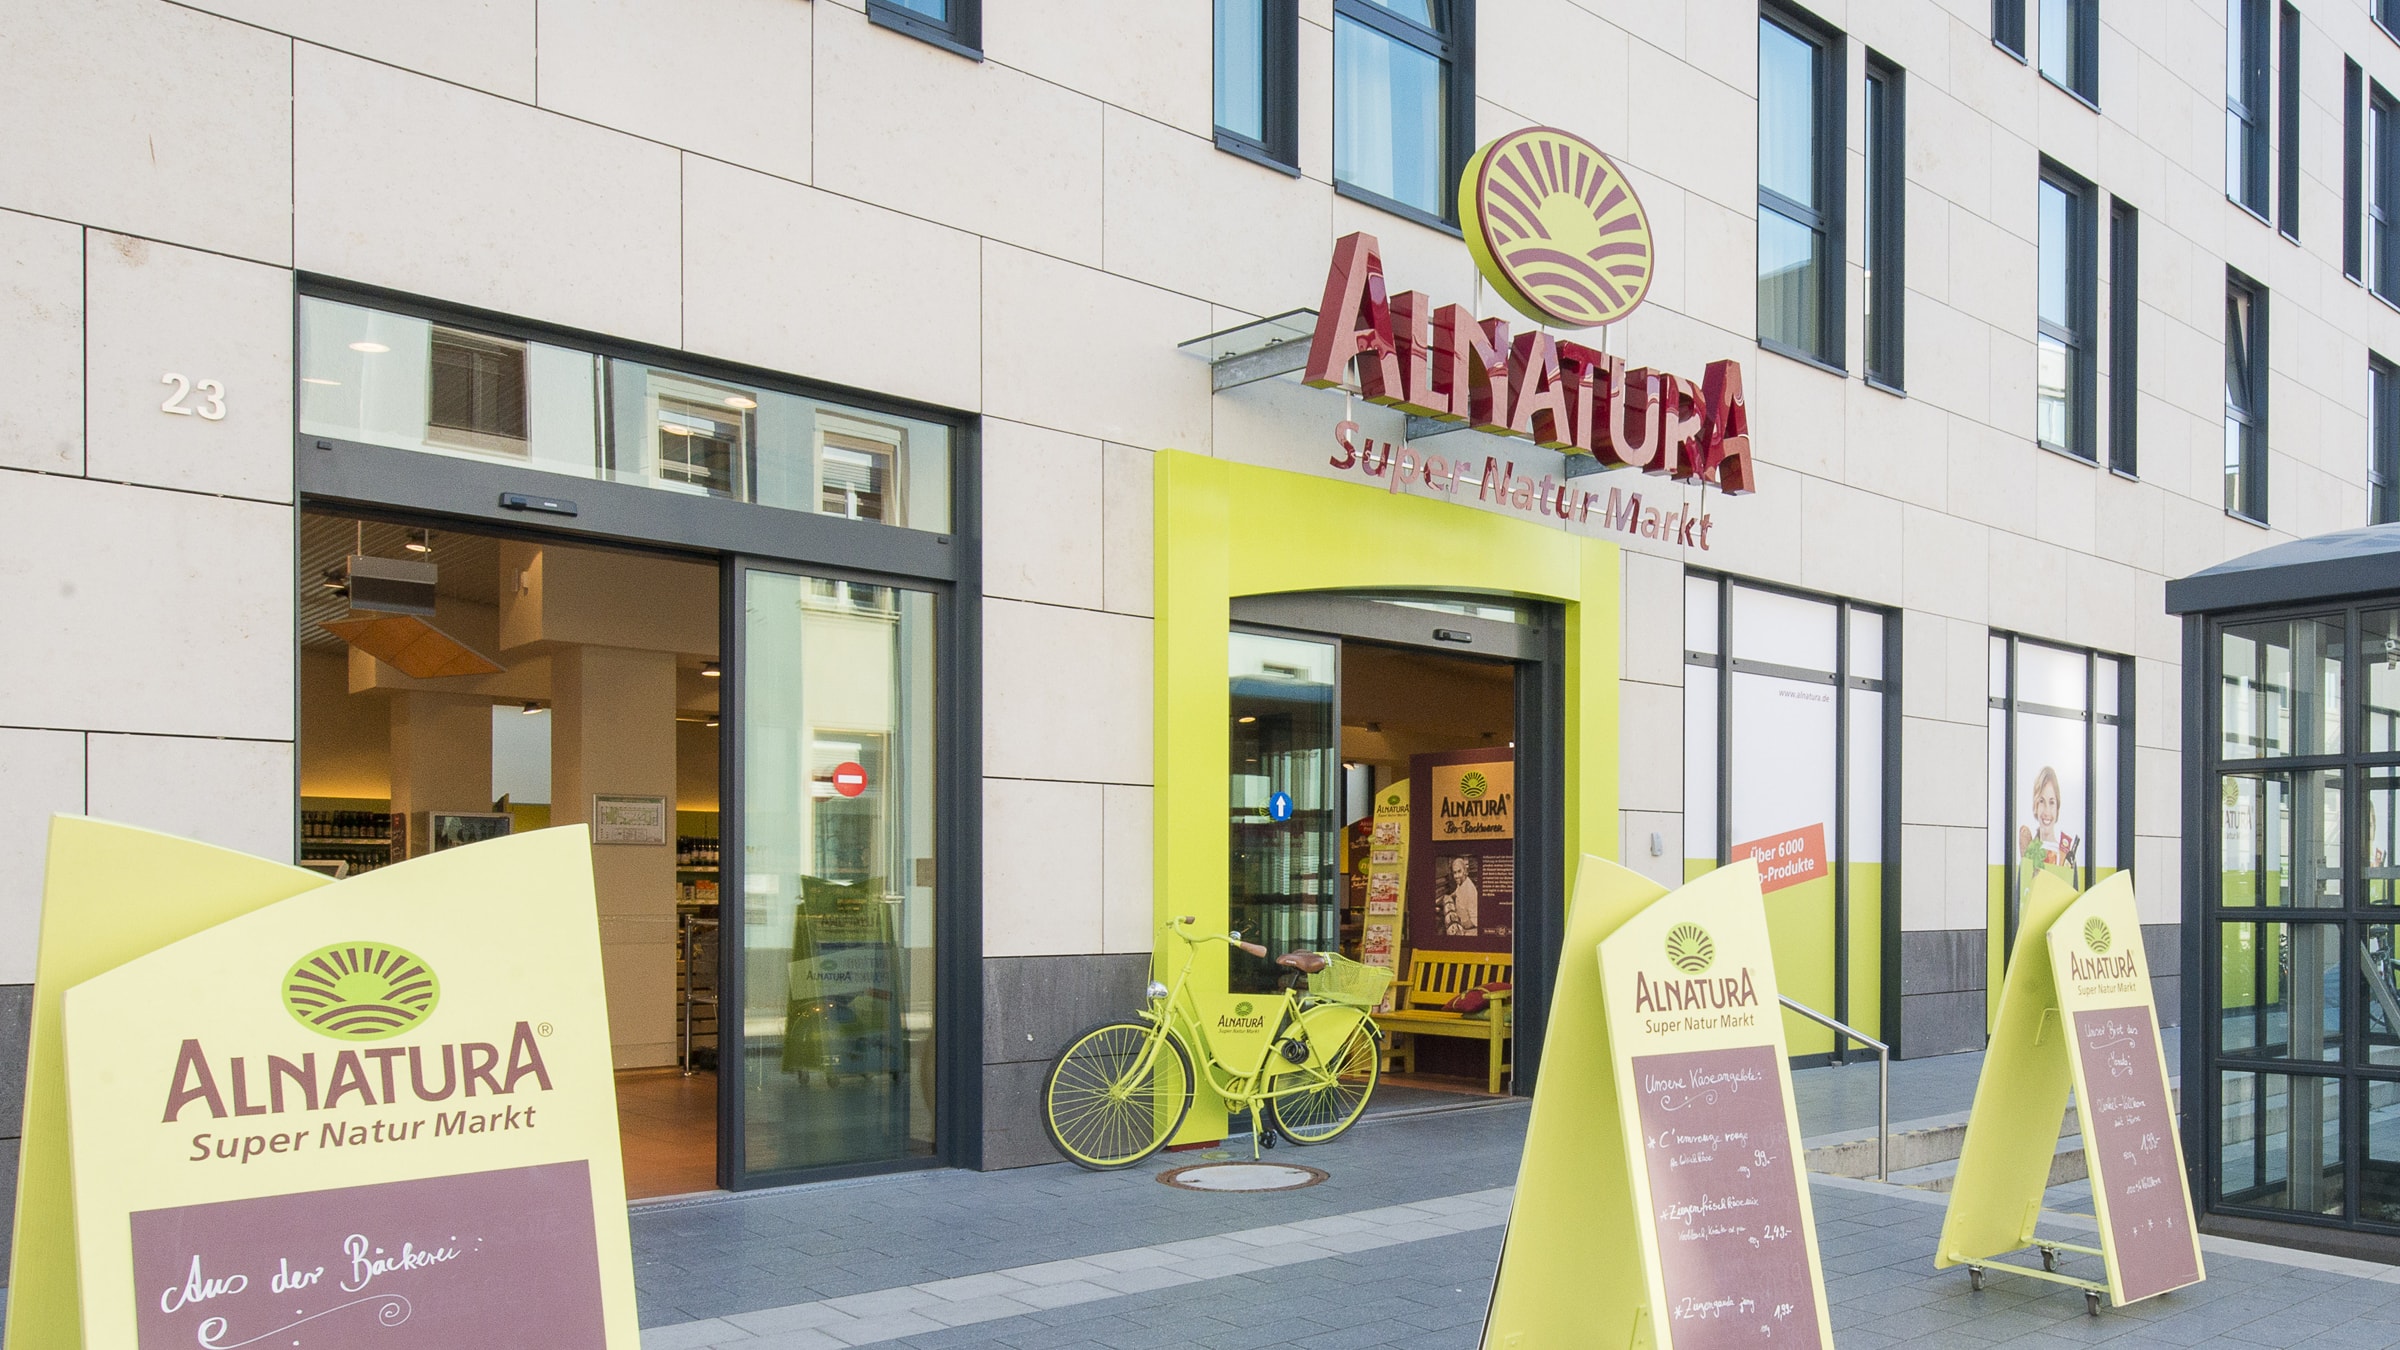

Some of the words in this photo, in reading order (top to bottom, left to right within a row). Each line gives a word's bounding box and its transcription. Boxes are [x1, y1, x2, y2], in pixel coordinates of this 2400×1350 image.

[1302, 231, 1756, 496] ALNATURA
[161, 372, 227, 421] 23
[1329, 420, 1471, 495] Super
[1479, 456, 1600, 524] Natur
[1605, 487, 1714, 552] Markt
[1778, 688, 1831, 703] www.alnatura.de
[1376, 804, 1410, 814] ALNATURA
[1440, 793, 1507, 818] ALNATURA
[2071, 949, 2138, 981] ALNATURA
[1636, 967, 1758, 1013] ALNATURA
[2078, 985, 2097, 996] Super
[2098, 983, 2116, 993] Natur
[2117, 982, 2137, 992] Markt
[1217, 1015, 1264, 1028] ALNATURA
[1645, 1019, 1681, 1036] Super
[1684, 1016, 1718, 1031] Natur
[1720, 1012, 1755, 1028] Markt
[162, 1021, 554, 1123] ALNATURA
[188, 1130, 310, 1165] Super
[319, 1117, 426, 1149] Natur
[433, 1105, 537, 1138] Markt
[160, 1254, 248, 1314] Aus
[271, 1258, 325, 1294] der
